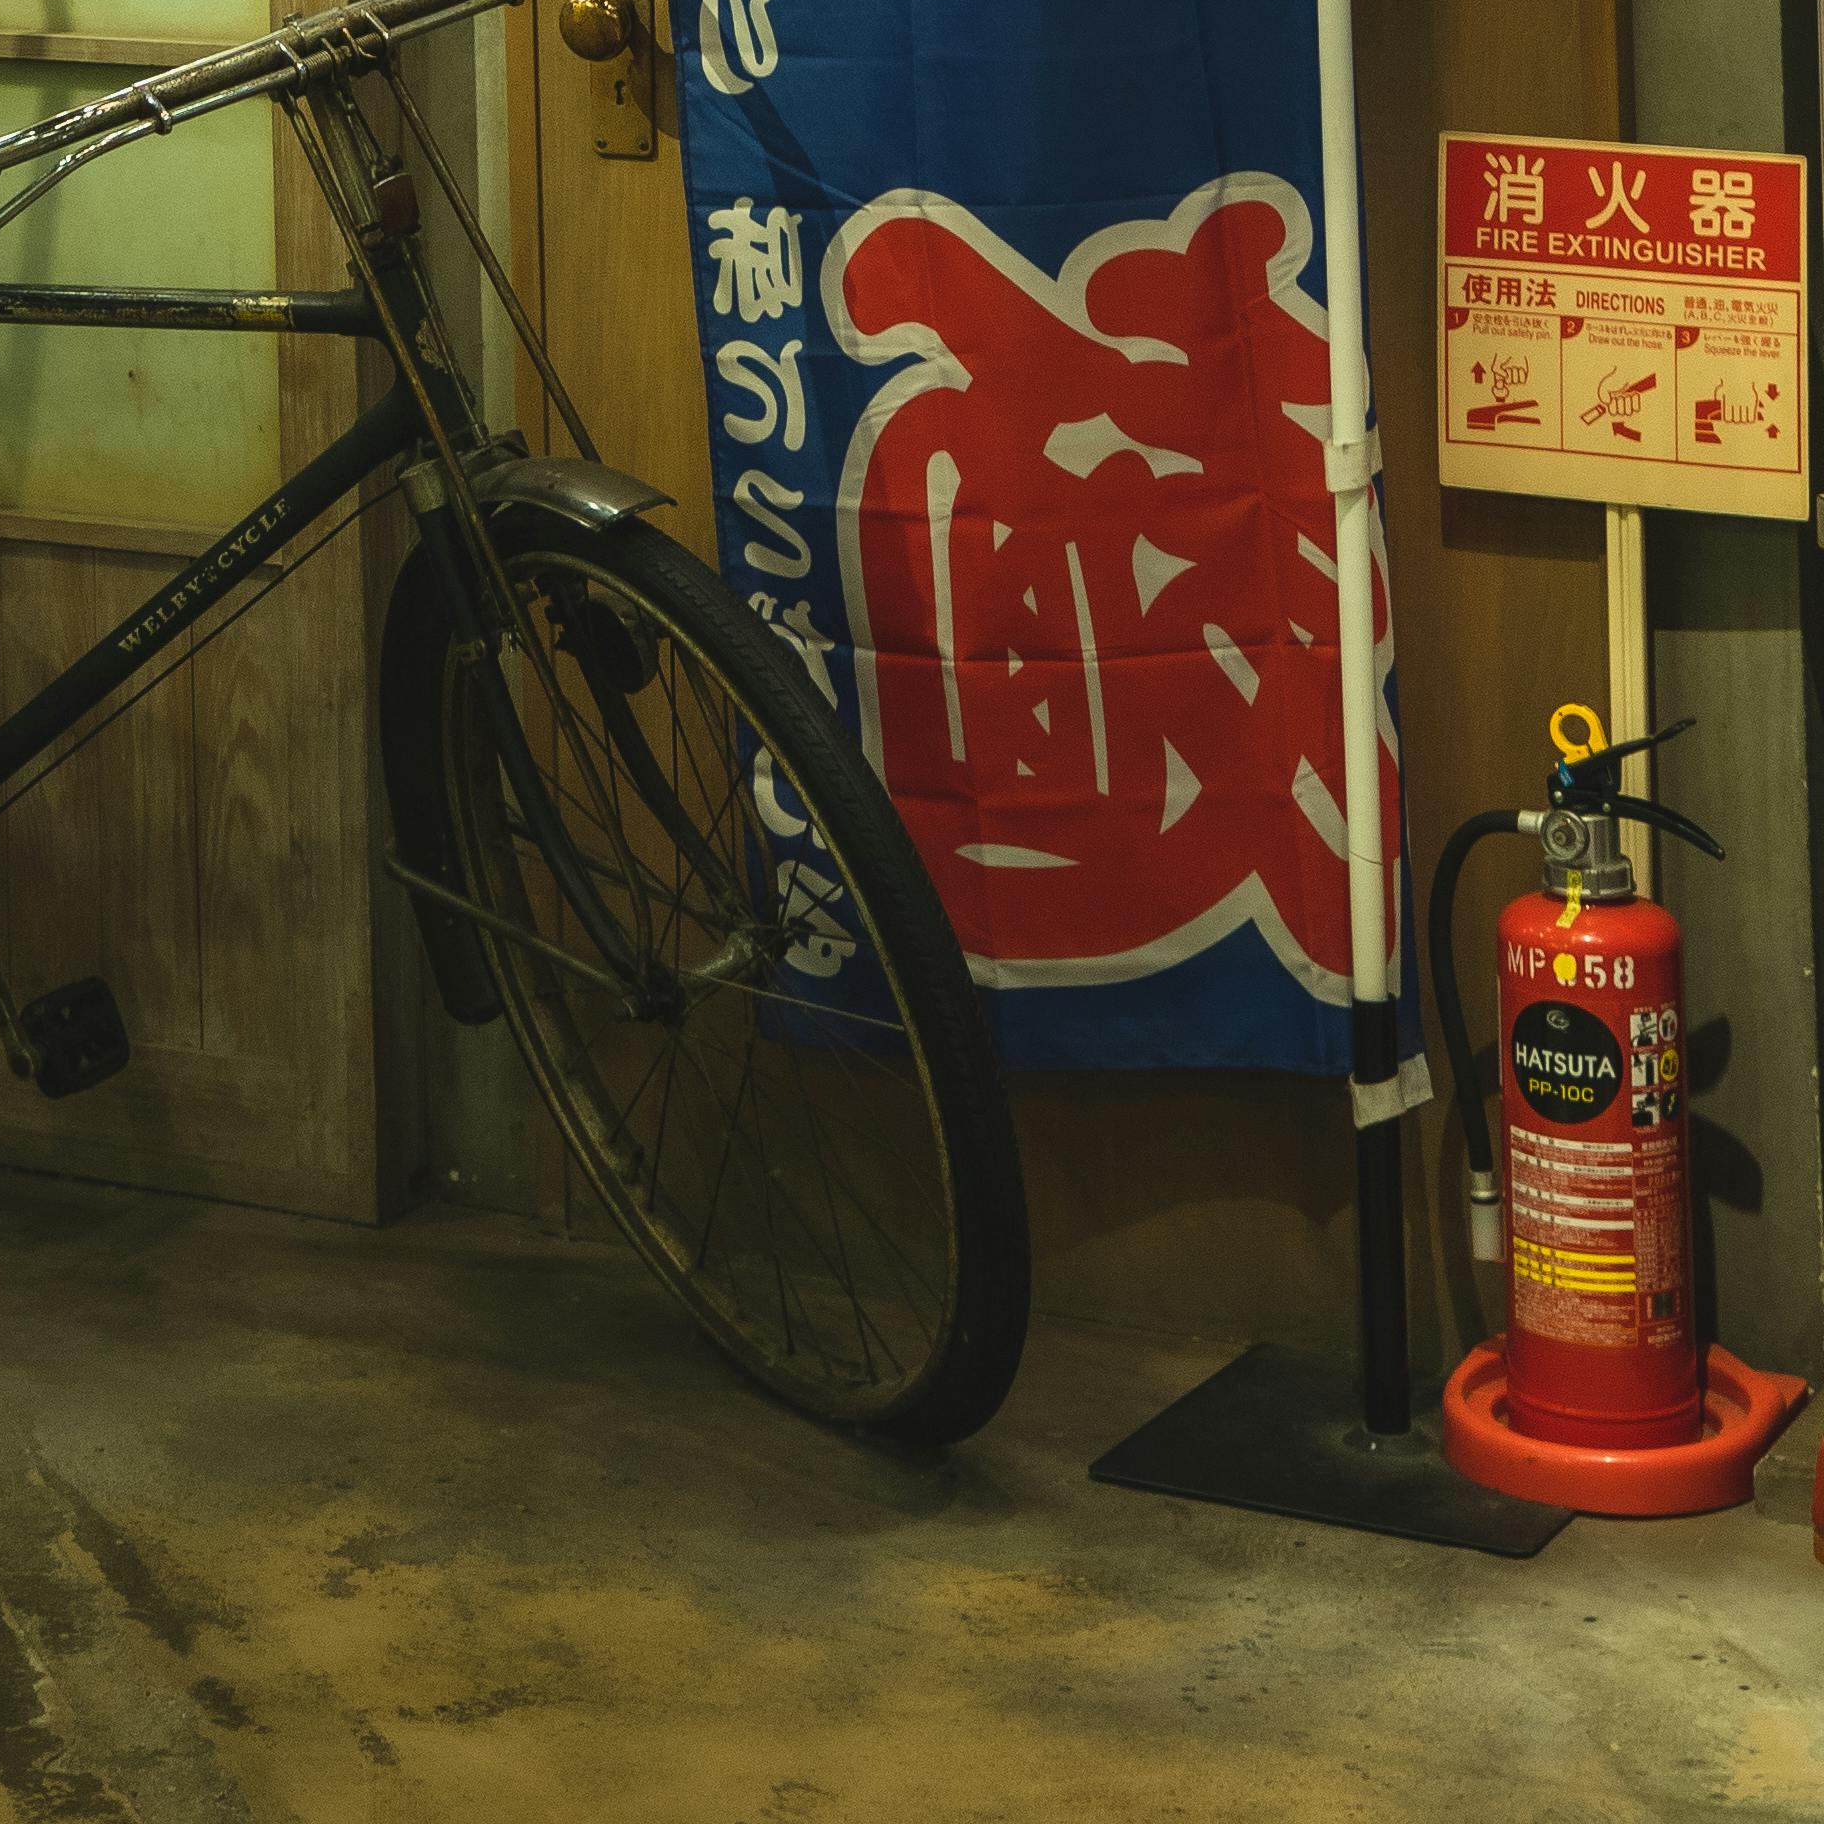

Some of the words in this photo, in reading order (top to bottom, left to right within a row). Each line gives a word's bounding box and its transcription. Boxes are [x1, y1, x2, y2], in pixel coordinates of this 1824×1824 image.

[1483, 151, 1756, 239] 消火器
[1476, 226, 1539, 254] FIRE
[1548, 232, 1767, 272] EXTINGUISHER
[1462, 272, 1557, 309] 使用法
[1575, 290, 1665, 316] DIRECTIONS
[1454, 312, 1461, 324] 1
[1472, 324, 1490, 335] Pull
[1491, 326, 1506, 336] out
[1507, 327, 1533, 340] safety
[1566, 320, 1577, 335] 2
[1588, 334, 1609, 345] Draw
[1611, 337, 1626, 346] out
[1627, 338, 1640, 347] the
[1680, 329, 1691, 344] 3
[1703, 344, 1742, 357] Squeeze
[1743, 347, 1758, 357] the
[1515, 1041, 1616, 1080] HATSUTA
